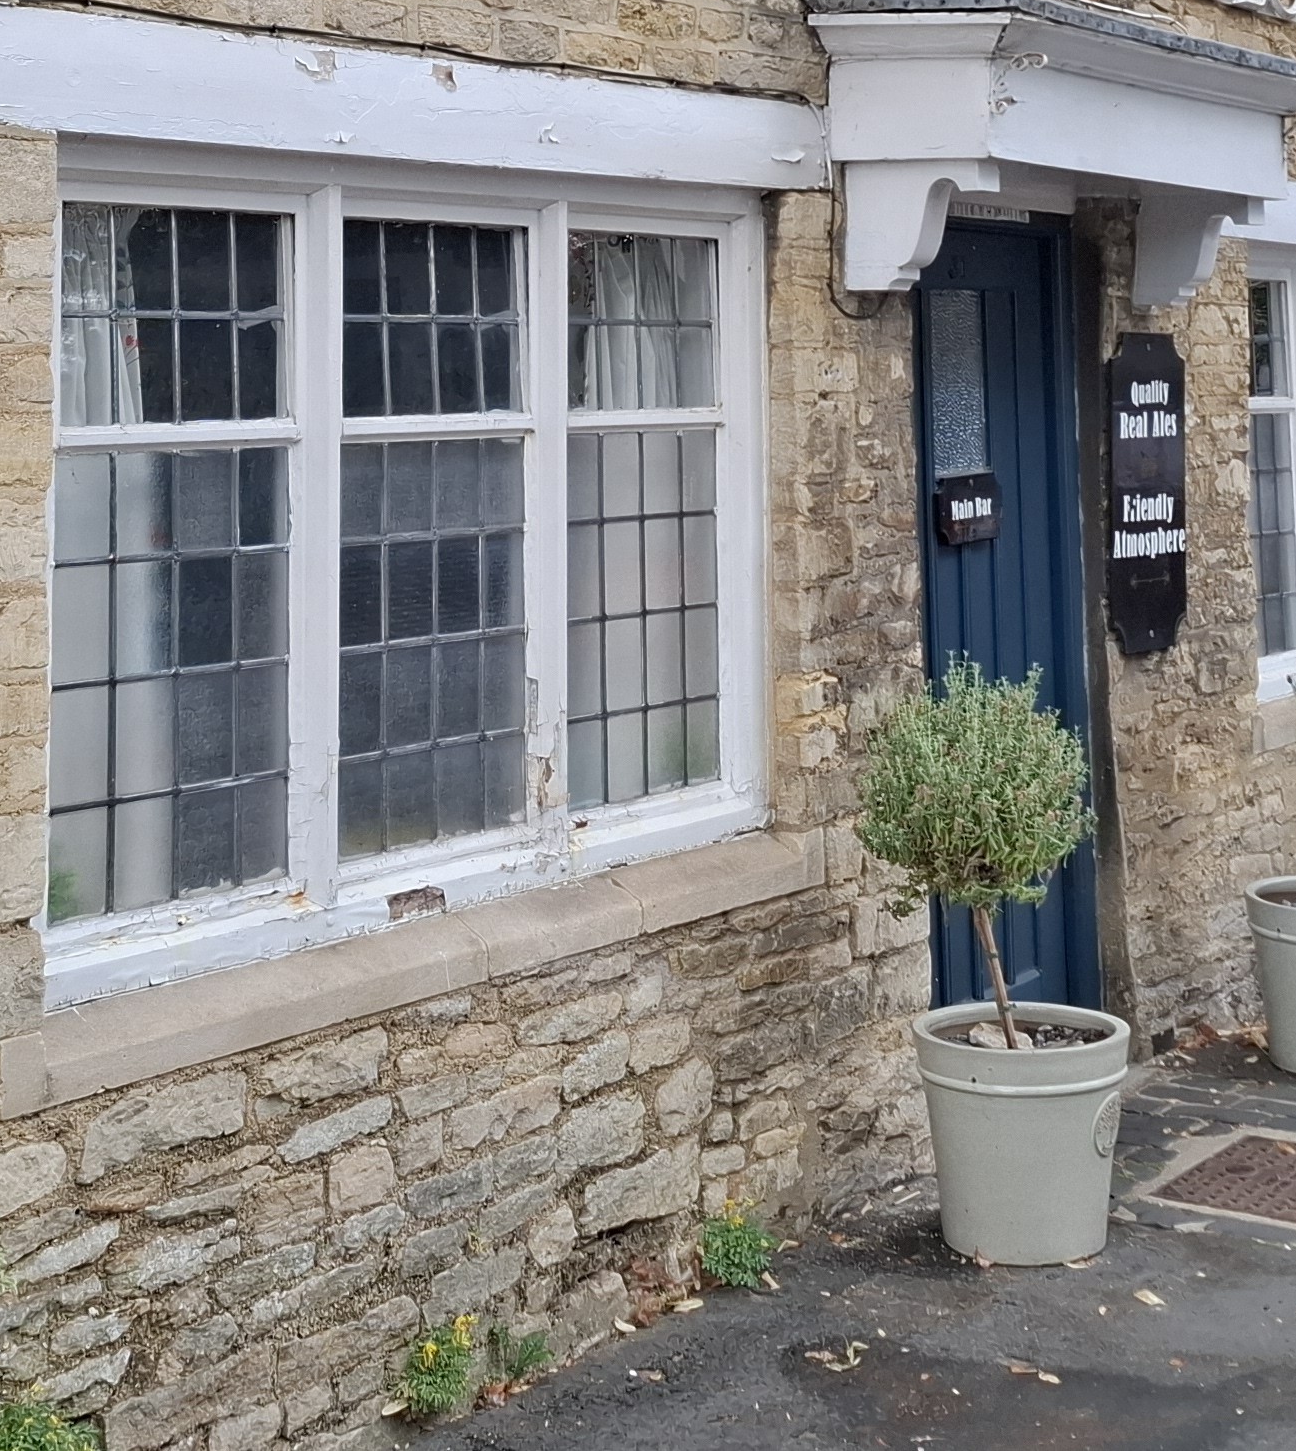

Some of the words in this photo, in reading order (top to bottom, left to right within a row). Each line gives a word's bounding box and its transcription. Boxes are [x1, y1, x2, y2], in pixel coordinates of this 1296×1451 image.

[1130, 379, 1170, 408] Quality
[1119, 411, 1149, 440] Real
[1151, 410, 1178, 438] Ales
[950, 498, 975, 521] Main
[974, 496, 993, 518] Bar
[1122, 492, 1175, 524] Friendly
[1112, 526, 1186, 559] Atmosphere
